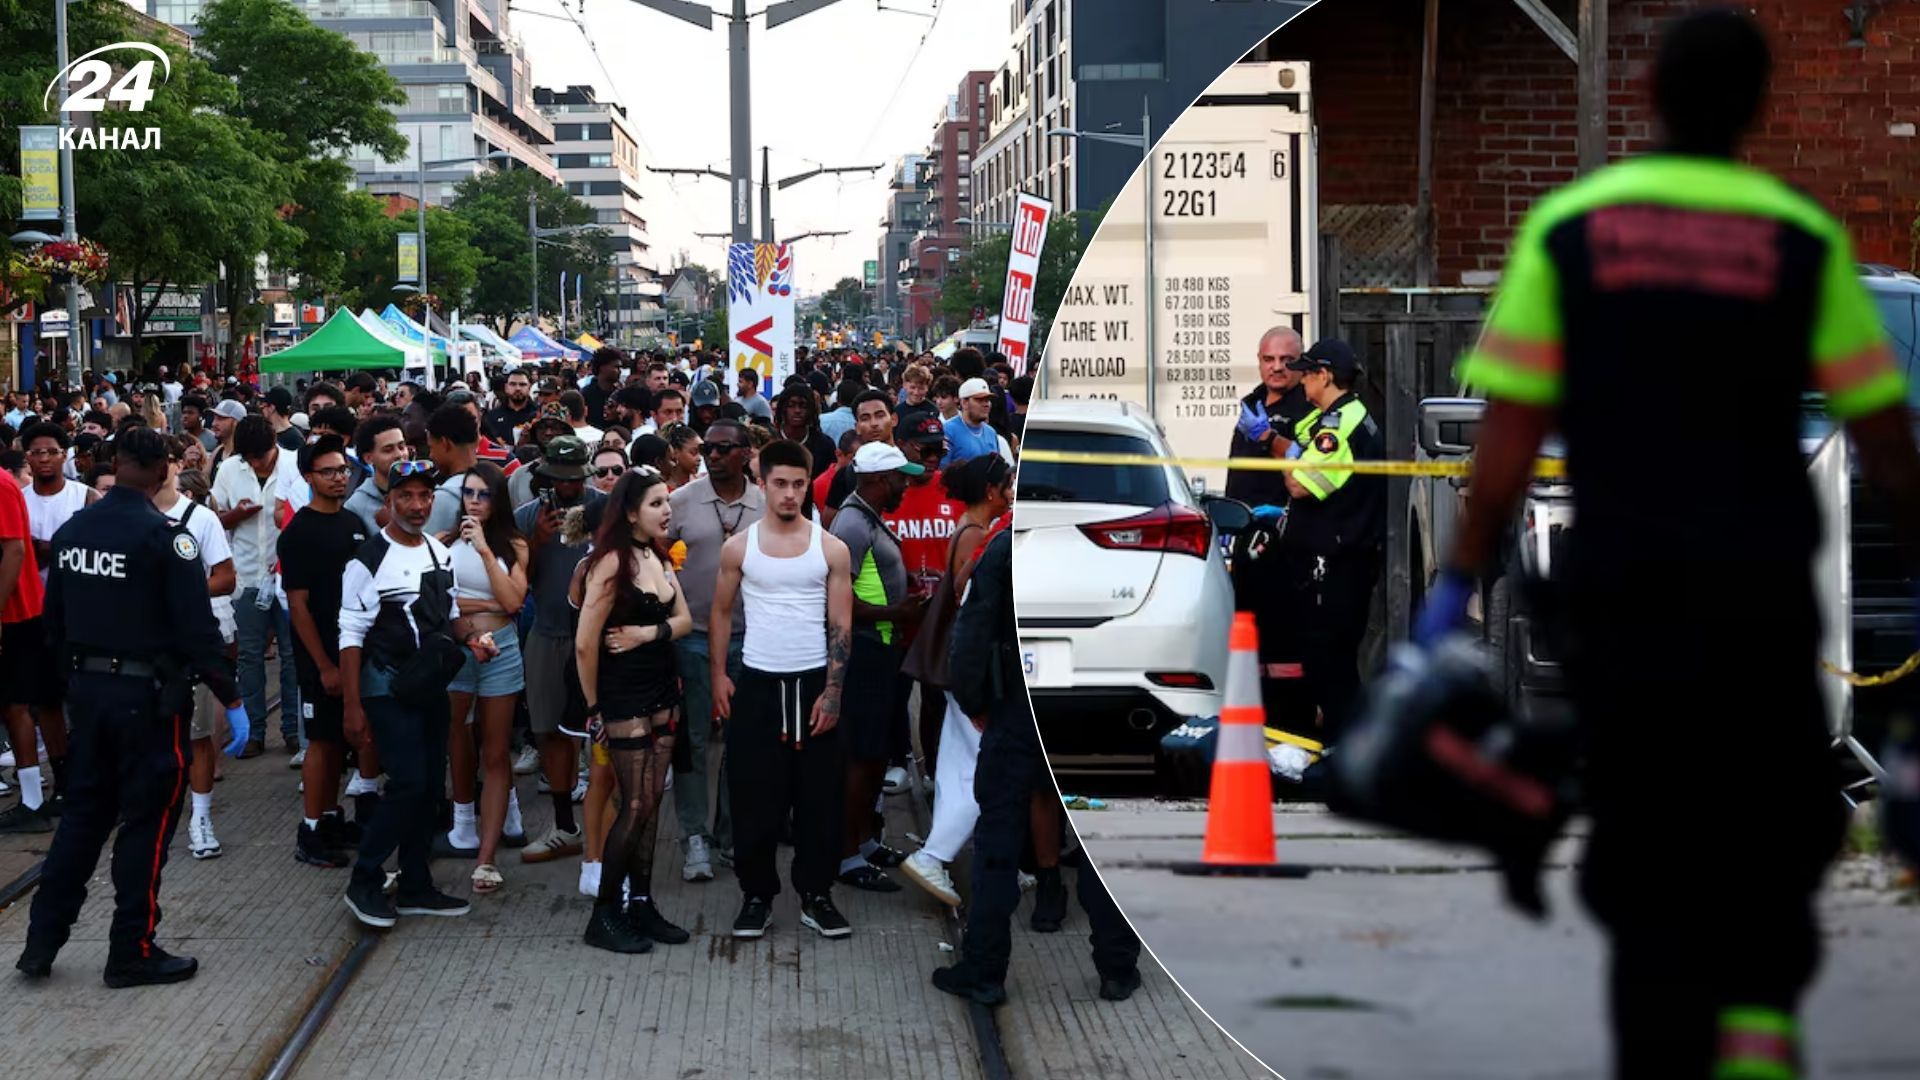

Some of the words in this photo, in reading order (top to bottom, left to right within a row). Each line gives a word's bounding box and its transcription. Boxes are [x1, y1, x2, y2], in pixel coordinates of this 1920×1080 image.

[1163, 151, 1246, 179] 212354
[1273, 151, 1286, 179] 6
[1163, 190, 1216, 217] 22G1
[1165, 277, 1205, 292] 30.480
[1208, 277, 1230, 292] KGS
[1103, 284, 1134, 306] WT.
[1165, 295, 1205, 310] 67.200
[1208, 295, 1230, 310] LBS
[1208, 313, 1230, 328] KGS
[1060, 321, 1096, 342] TARE
[1103, 320, 1134, 342] WT.
[1172, 331, 1205, 346] 4.370
[1208, 331, 1230, 346] LBS
[1166, 349, 1205, 364] 28.500
[1208, 349, 1231, 364] KGS
[1059, 356, 1126, 378] PAYLOAD
[1166, 368, 1205, 382] 62.830
[1209, 368, 1231, 382] LBS
[1181, 385, 1205, 399] 33.2
[58, 546, 127, 579] POLICE
